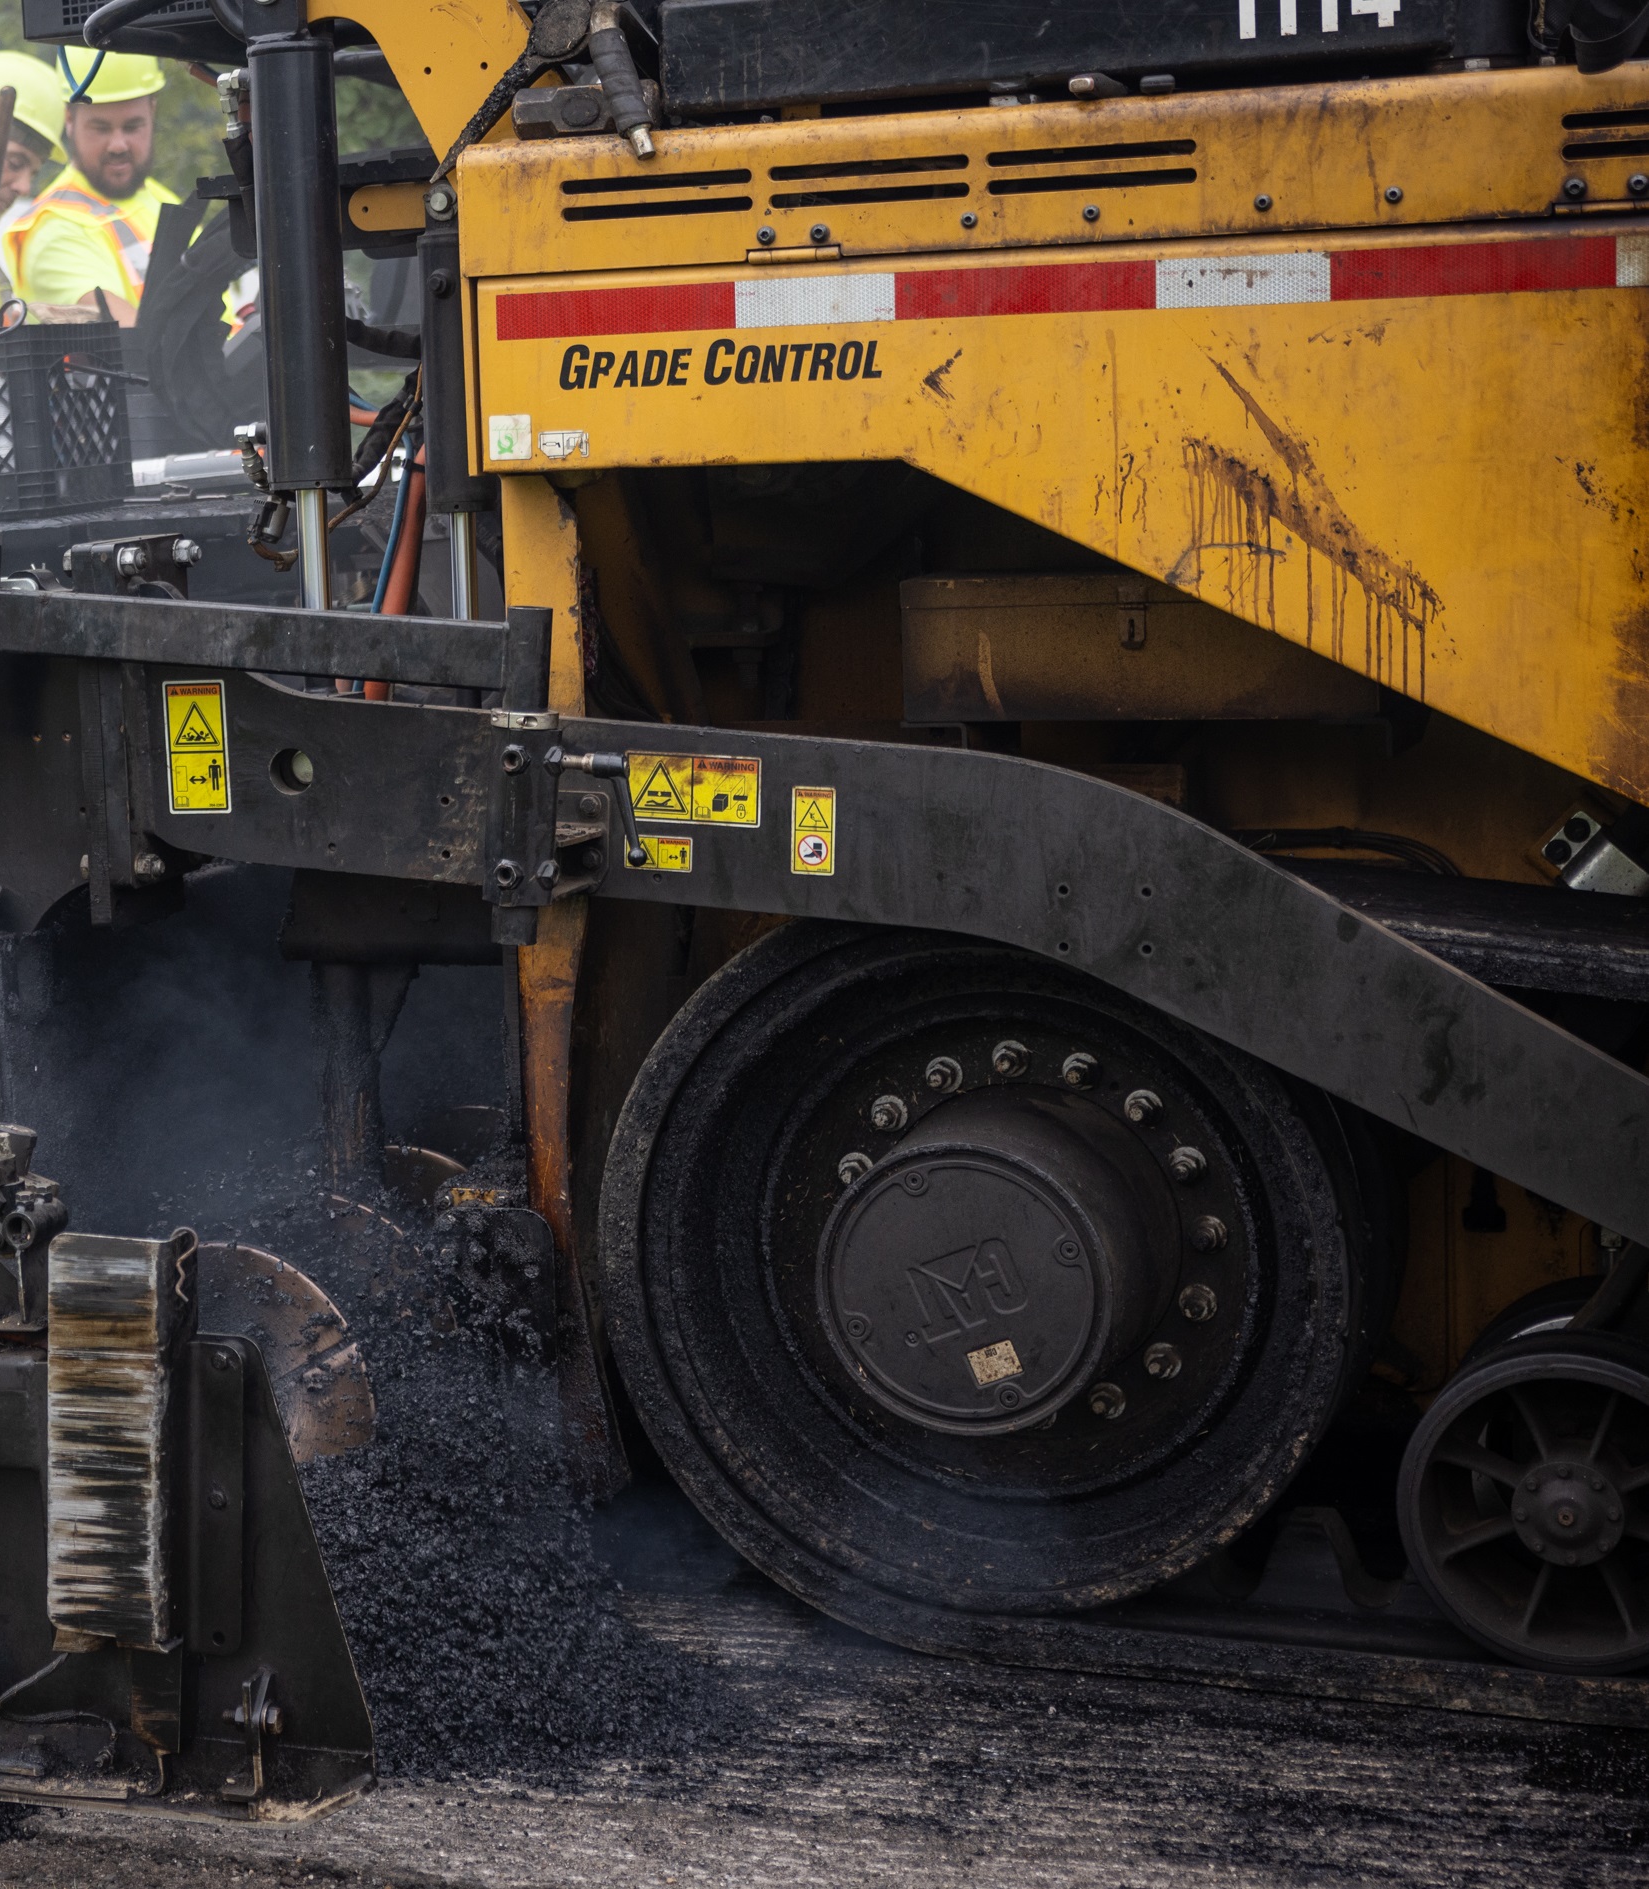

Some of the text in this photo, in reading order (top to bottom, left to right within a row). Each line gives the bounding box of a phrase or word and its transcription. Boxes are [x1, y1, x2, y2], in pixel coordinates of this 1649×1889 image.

[704, 338, 883, 386] CONTROL
[180, 687, 218, 696] WARNING
[709, 760, 755, 772] WARNING
[906, 1238, 1029, 1344] CAT
